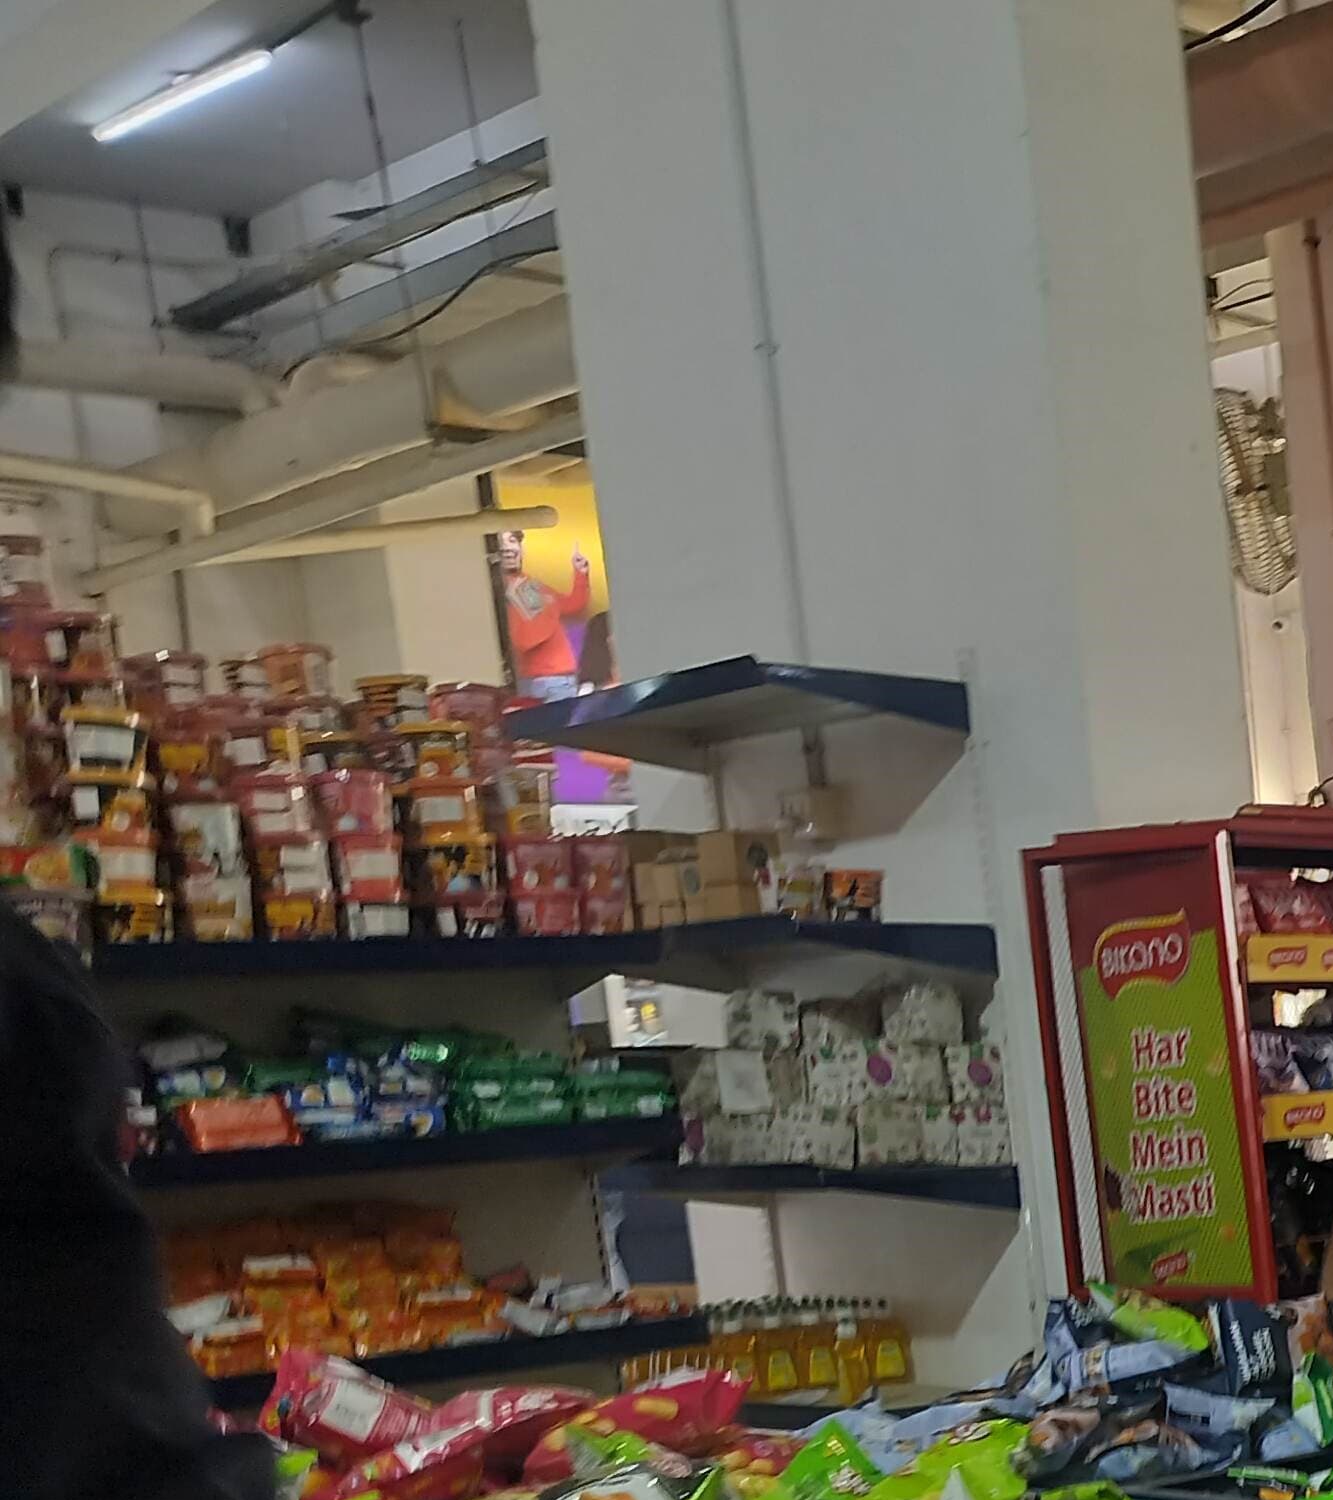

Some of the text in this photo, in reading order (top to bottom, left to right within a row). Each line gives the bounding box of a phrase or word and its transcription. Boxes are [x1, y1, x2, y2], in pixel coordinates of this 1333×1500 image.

[1130, 1024, 1191, 1073] Har
[1132, 1074, 1197, 1123] Bite
[1130, 1123, 1208, 1174] Mein
[1122, 1167, 1215, 1224] Masti
